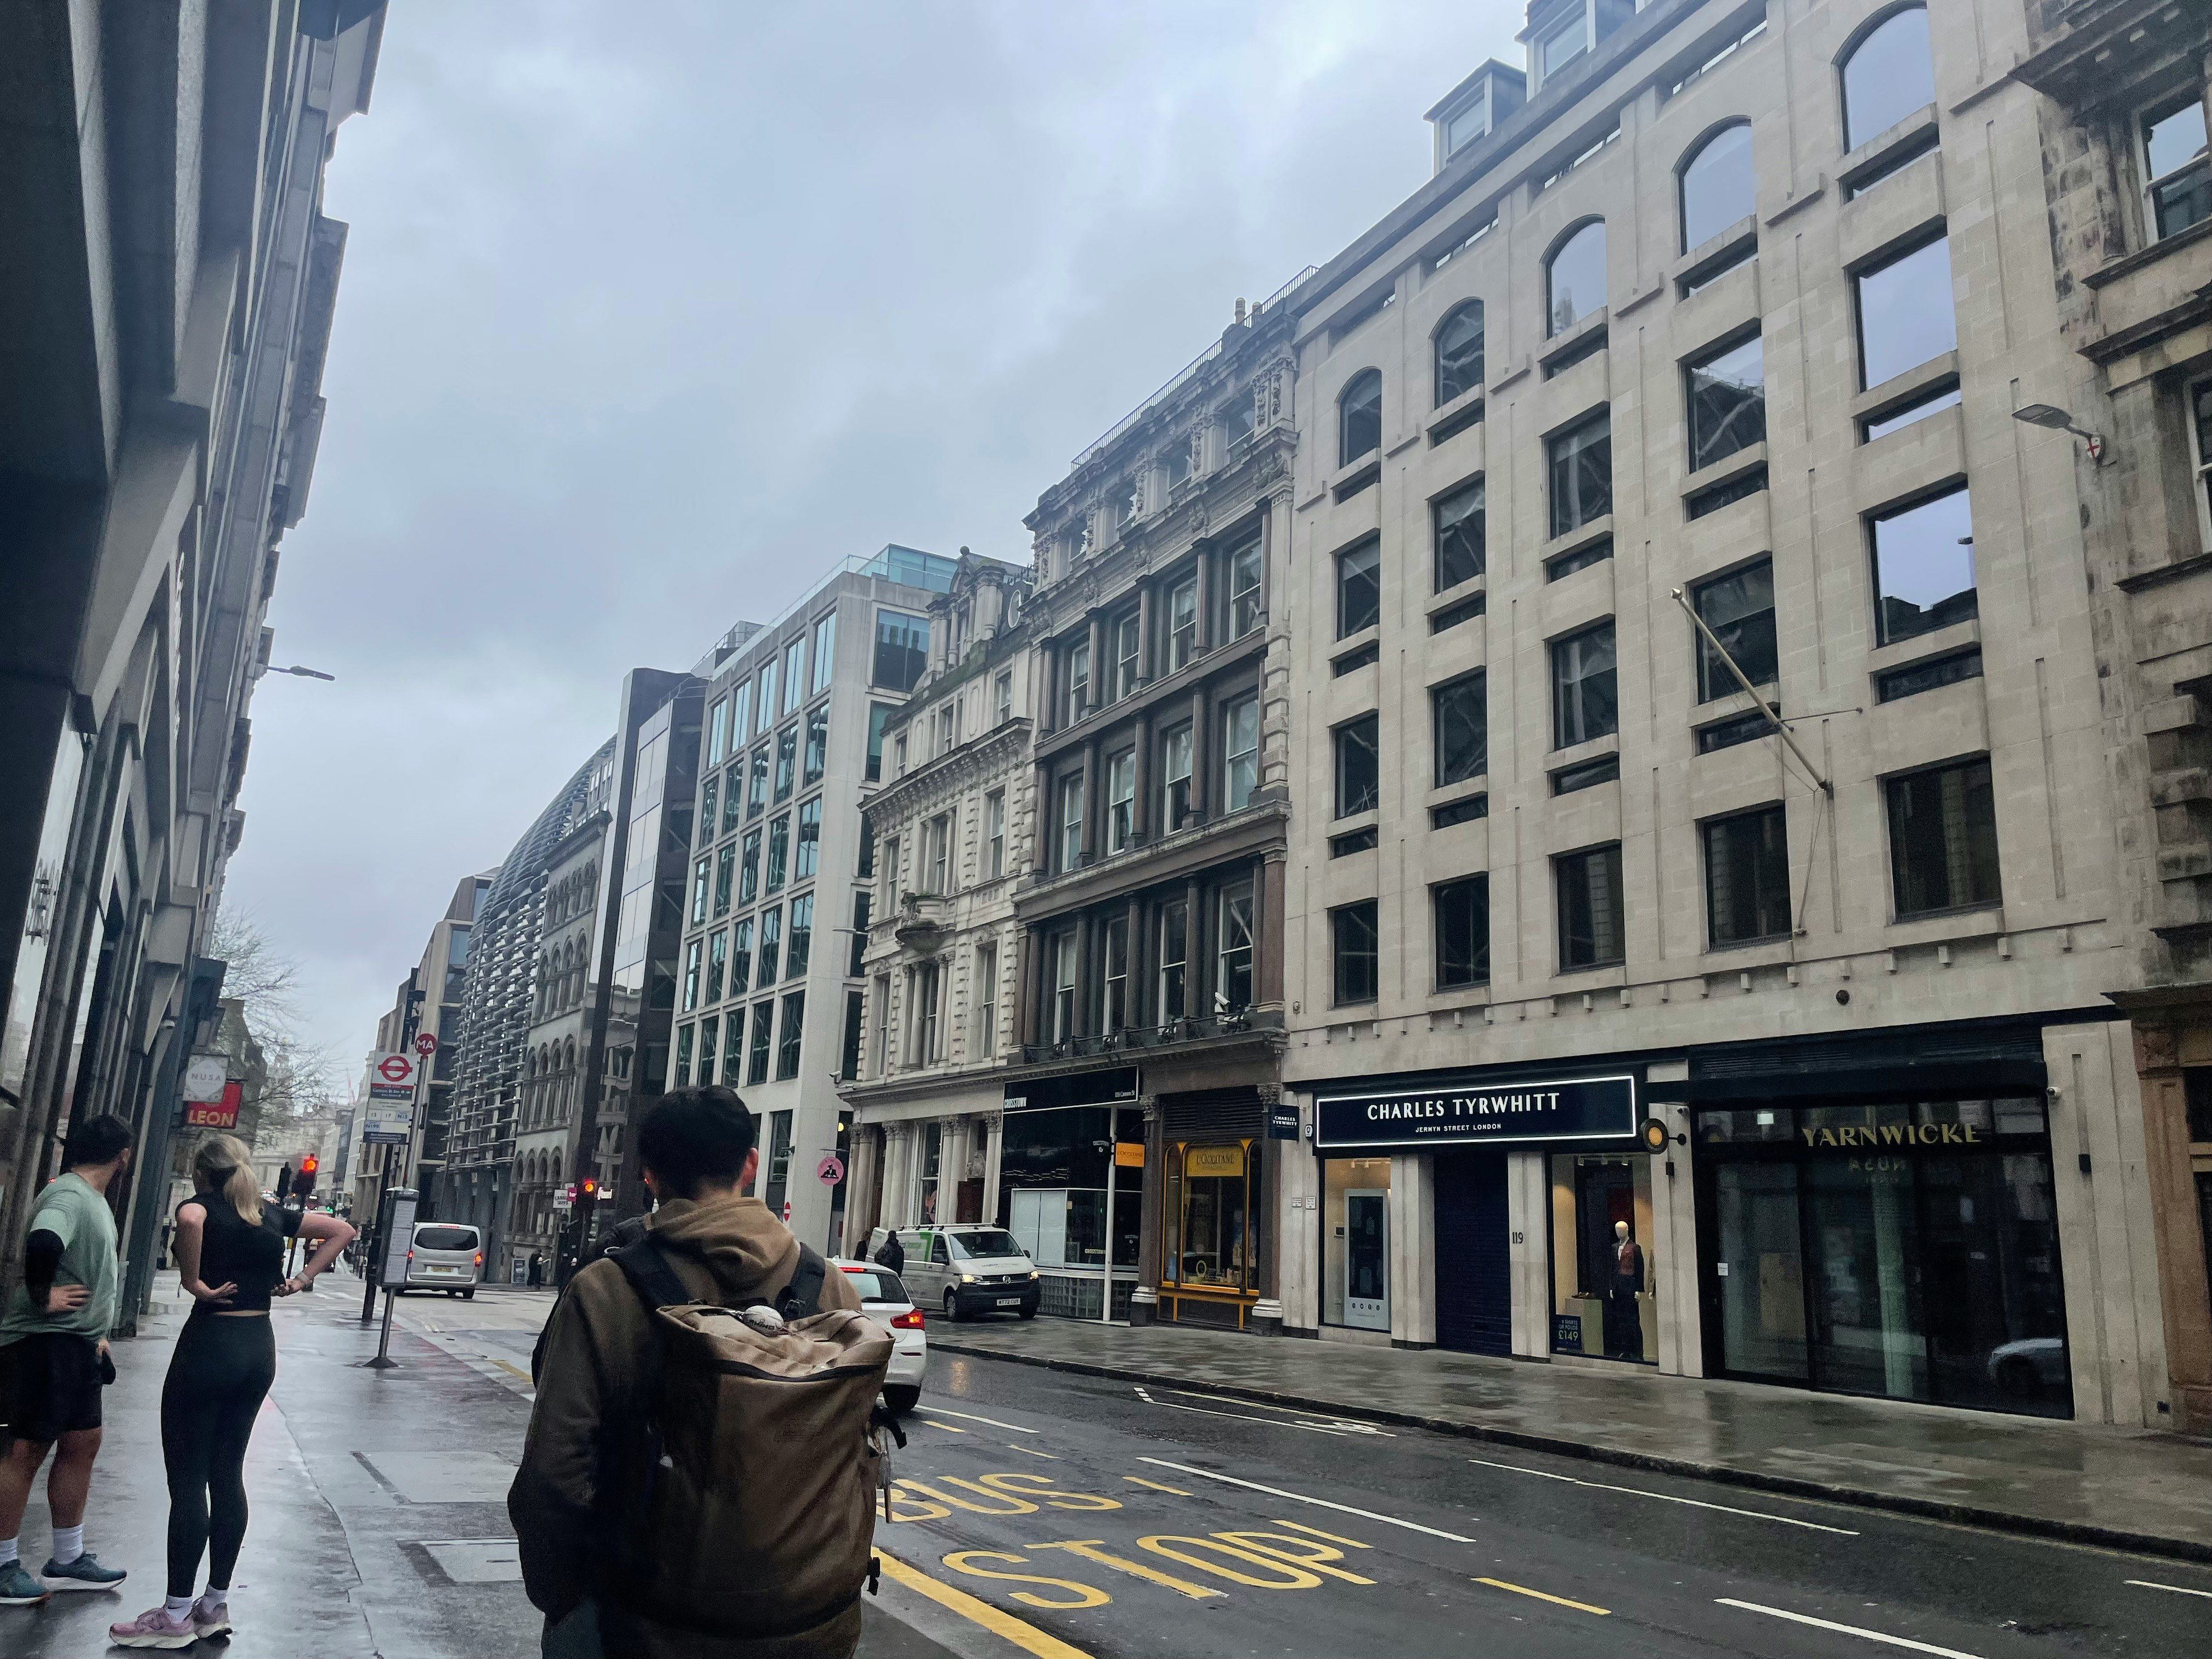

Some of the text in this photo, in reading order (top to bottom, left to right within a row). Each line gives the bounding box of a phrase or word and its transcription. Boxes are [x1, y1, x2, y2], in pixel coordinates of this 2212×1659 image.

[416, 1040, 433, 1049] MA
[1367, 1092, 1560, 1120] CHARLES TYRWHITT
[188, 1110, 234, 1126] LEON
[1802, 1124, 1982, 1147] YARNWICKE
[1512, 1232, 1523, 1244] 119
[1558, 1330, 1578, 1341] £149
[876, 1473, 1123, 1522] BUS
[942, 1531, 1379, 1609] STOP
